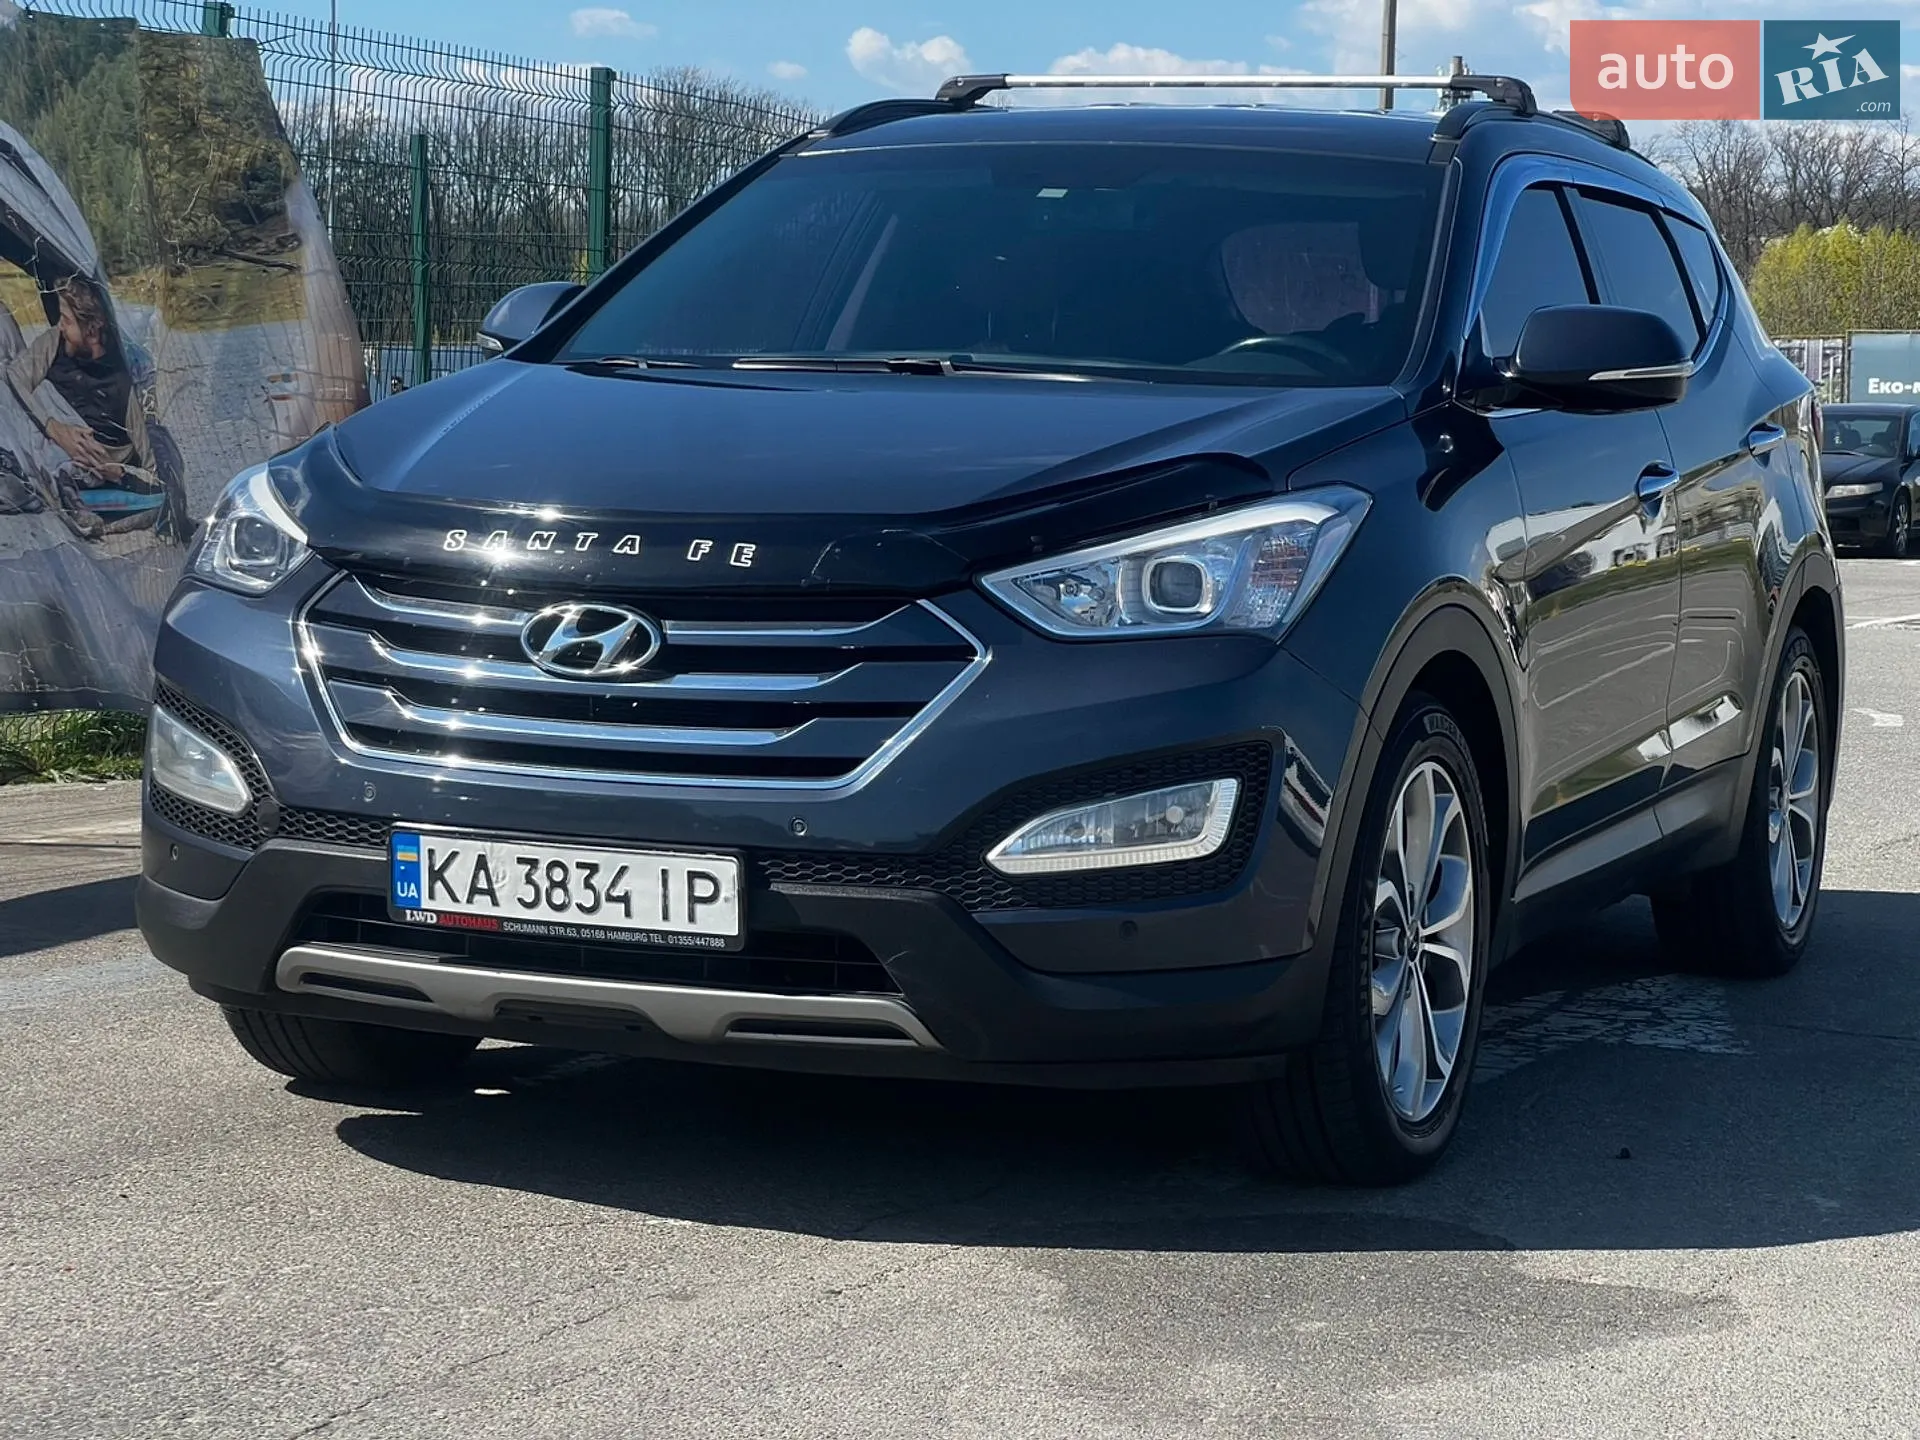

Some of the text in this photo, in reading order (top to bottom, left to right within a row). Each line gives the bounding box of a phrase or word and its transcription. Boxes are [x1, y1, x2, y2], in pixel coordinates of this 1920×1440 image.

[443, 529, 756, 567] SANTA FE
[396, 881, 419, 899] UA
[426, 847, 722, 923] KA 3834 IP
[405, 909, 437, 924] LWD
[439, 914, 499, 931] AUTOHAUS
[502, 921, 548, 935] SCHUMANN
[606, 931, 648, 943] HAMBURG
